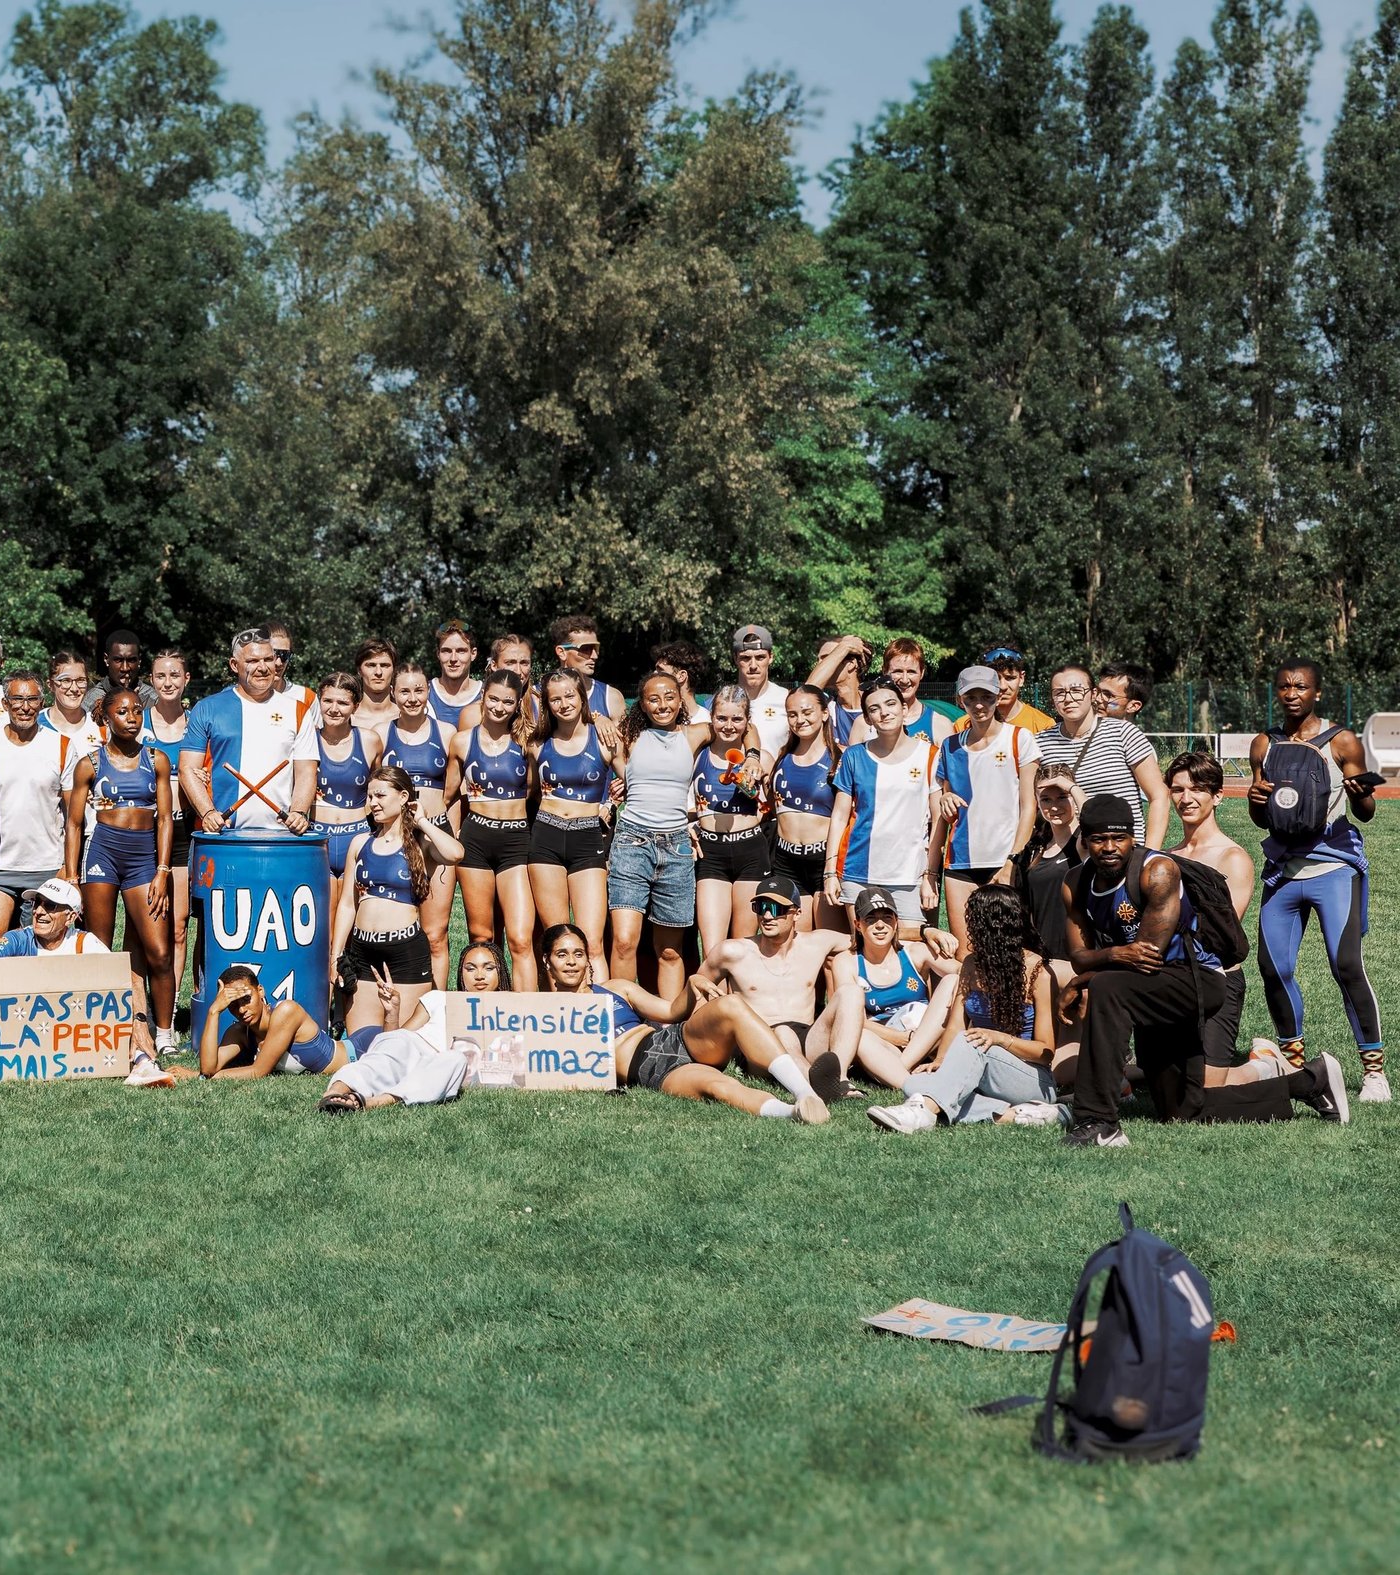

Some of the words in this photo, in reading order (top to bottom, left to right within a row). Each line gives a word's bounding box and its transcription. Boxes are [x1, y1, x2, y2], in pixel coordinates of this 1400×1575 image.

[327, 823, 355, 834] NIKE
[471, 814, 500, 829] NIKE
[501, 820, 527, 829] PRO
[722, 829, 753, 842] NIKE
[778, 837, 801, 855] NIKE
[211, 884, 316, 952] UAO
[359, 931, 386, 942] NIKE
[389, 925, 415, 941] PRO
[86, 990, 133, 1022] PAS
[53, 1023, 133, 1053] PERF
[528, 1049, 612, 1078] max
